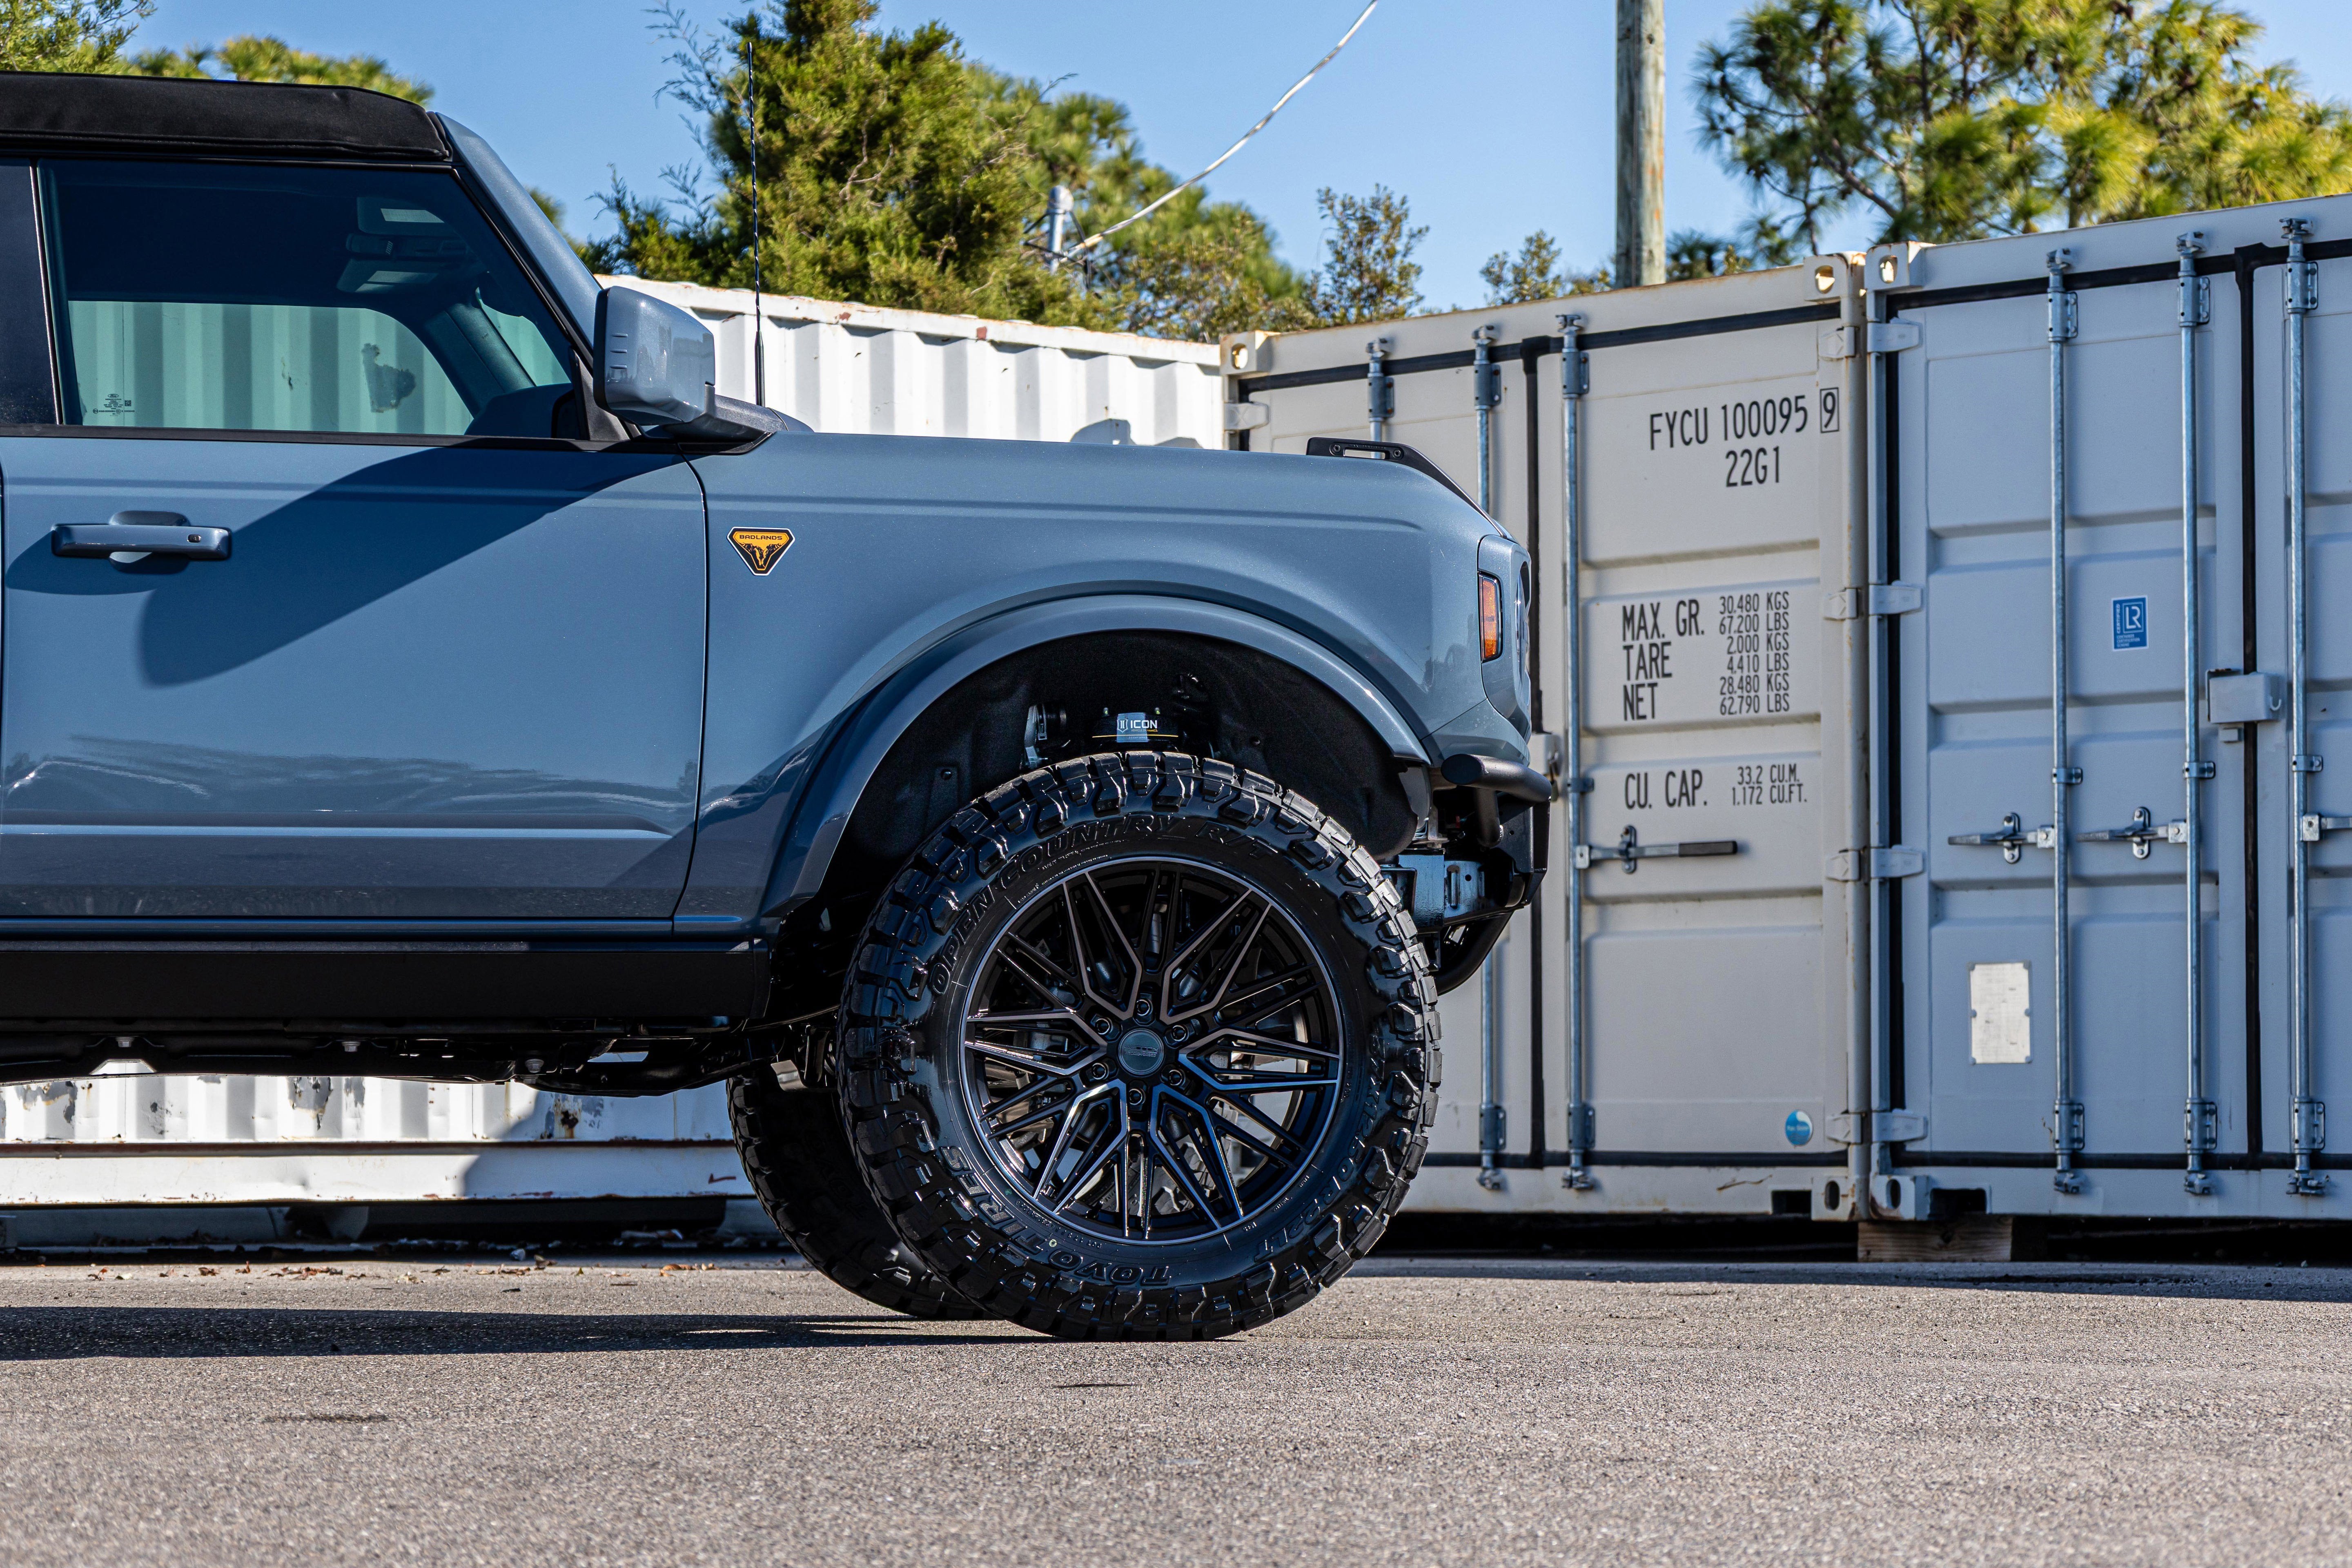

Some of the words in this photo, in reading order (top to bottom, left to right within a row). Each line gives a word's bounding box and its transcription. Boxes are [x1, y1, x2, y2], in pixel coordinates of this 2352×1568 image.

[1650, 407, 1708, 450] FYCU
[1721, 394, 1808, 441] 100095
[1823, 392, 1836, 428] 9
[1725, 446, 1780, 488] 22G1
[1719, 593, 1760, 614] 30.480
[1766, 591, 1789, 611] KGS
[1622, 602, 1665, 641] MAX.
[1676, 599, 1705, 637] GR.
[1719, 614, 1760, 635] 67.200
[1766, 612, 1789, 631] LBS
[2125, 605, 2142, 629] LR
[1727, 634, 1760, 655] 2.000
[1766, 632, 1789, 652] KGS
[1623, 641, 1673, 681] TARE
[1727, 654, 1760, 674] 4.410
[1766, 652, 1789, 672] LBS
[1719, 675, 1760, 695] 28.480
[1766, 673, 1790, 692] KGS
[1623, 682, 1658, 721] NET
[1719, 695, 1760, 715] 62.790
[1766, 693, 1790, 713] LBS
[1130, 720, 1157, 729] ICON
[1737, 766, 1763, 785] 33.2
[1770, 763, 1800, 784] CU.M.
[1624, 772, 1652, 810] CU.
[1665, 769, 1707, 808] CAP.
[1732, 786, 1763, 806] 1.172
[1770, 783, 1807, 804] CU.FT.
[929, 884, 996, 995] OPEN
[996, 814, 1185, 889] COUNTRY
[940, 1145, 1048, 1254] TIRES
[1049, 1250, 1169, 1286] TOYO
